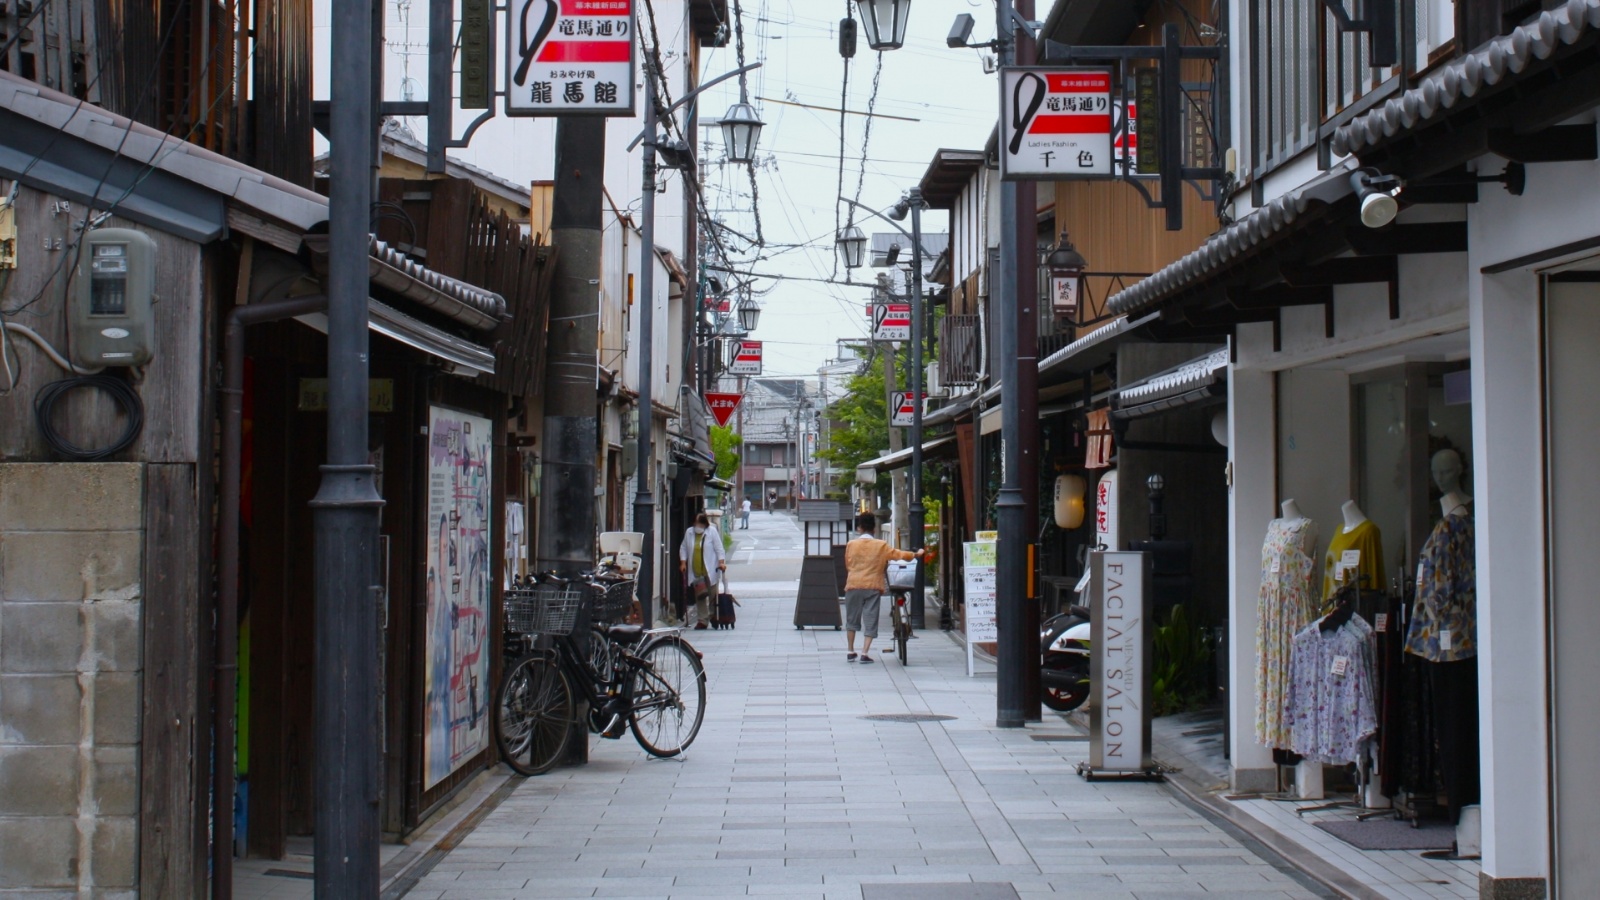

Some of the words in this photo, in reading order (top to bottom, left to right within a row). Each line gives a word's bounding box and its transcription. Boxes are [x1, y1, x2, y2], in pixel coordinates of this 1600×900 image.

[558, 19, 628, 36] 竜馬通り
[549, 70, 596, 79] おみやげ処
[531, 80, 618, 104] 龍馬館
[1046, 96, 1107, 112] 竜馬通り
[1039, 150, 1094, 168] 千色
[711, 399, 734, 408] 止まれ
[1107, 563, 1124, 657] FACIAL
[1123, 637, 1134, 691] MENARD
[1106, 668, 1123, 758] SALON
